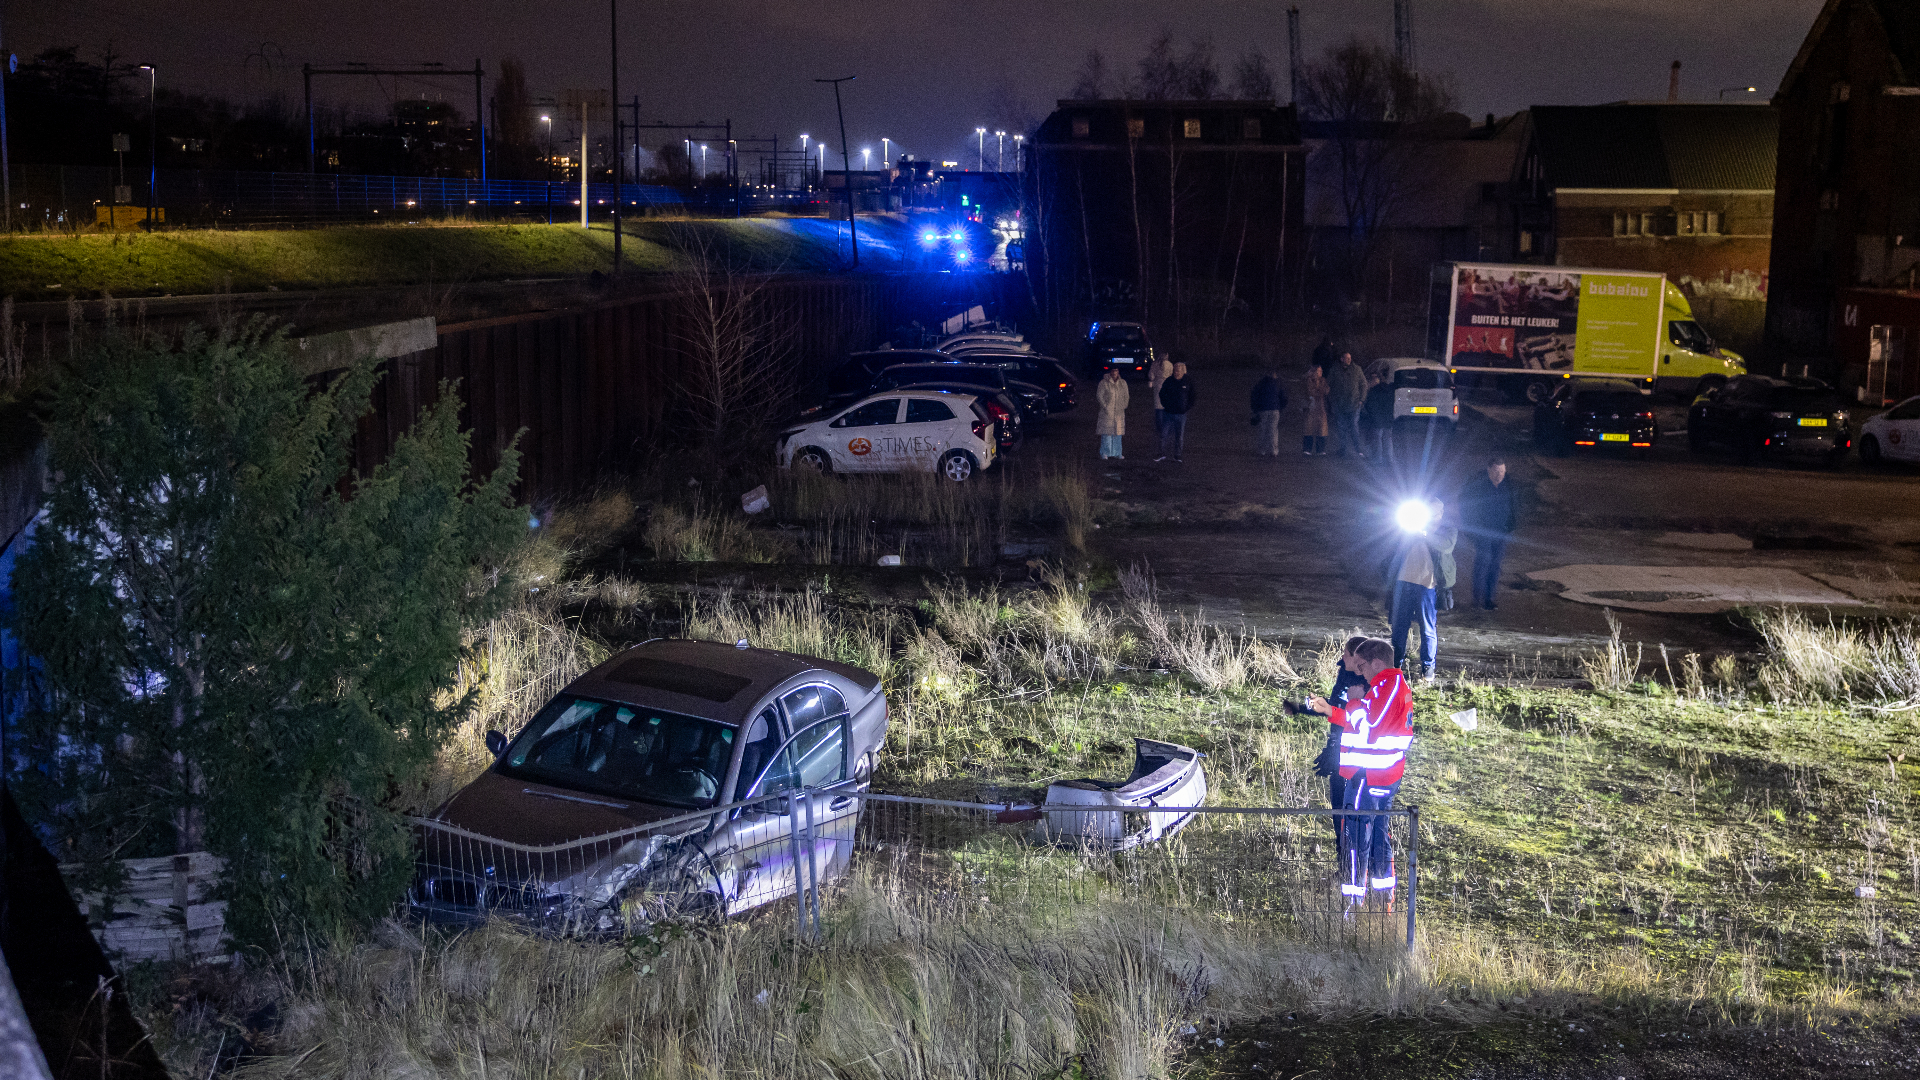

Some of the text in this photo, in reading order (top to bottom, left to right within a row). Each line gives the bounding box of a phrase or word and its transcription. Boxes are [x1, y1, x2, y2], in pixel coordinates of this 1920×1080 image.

[1471, 314, 1559, 328] BUITEN IS HET LEUKER!
